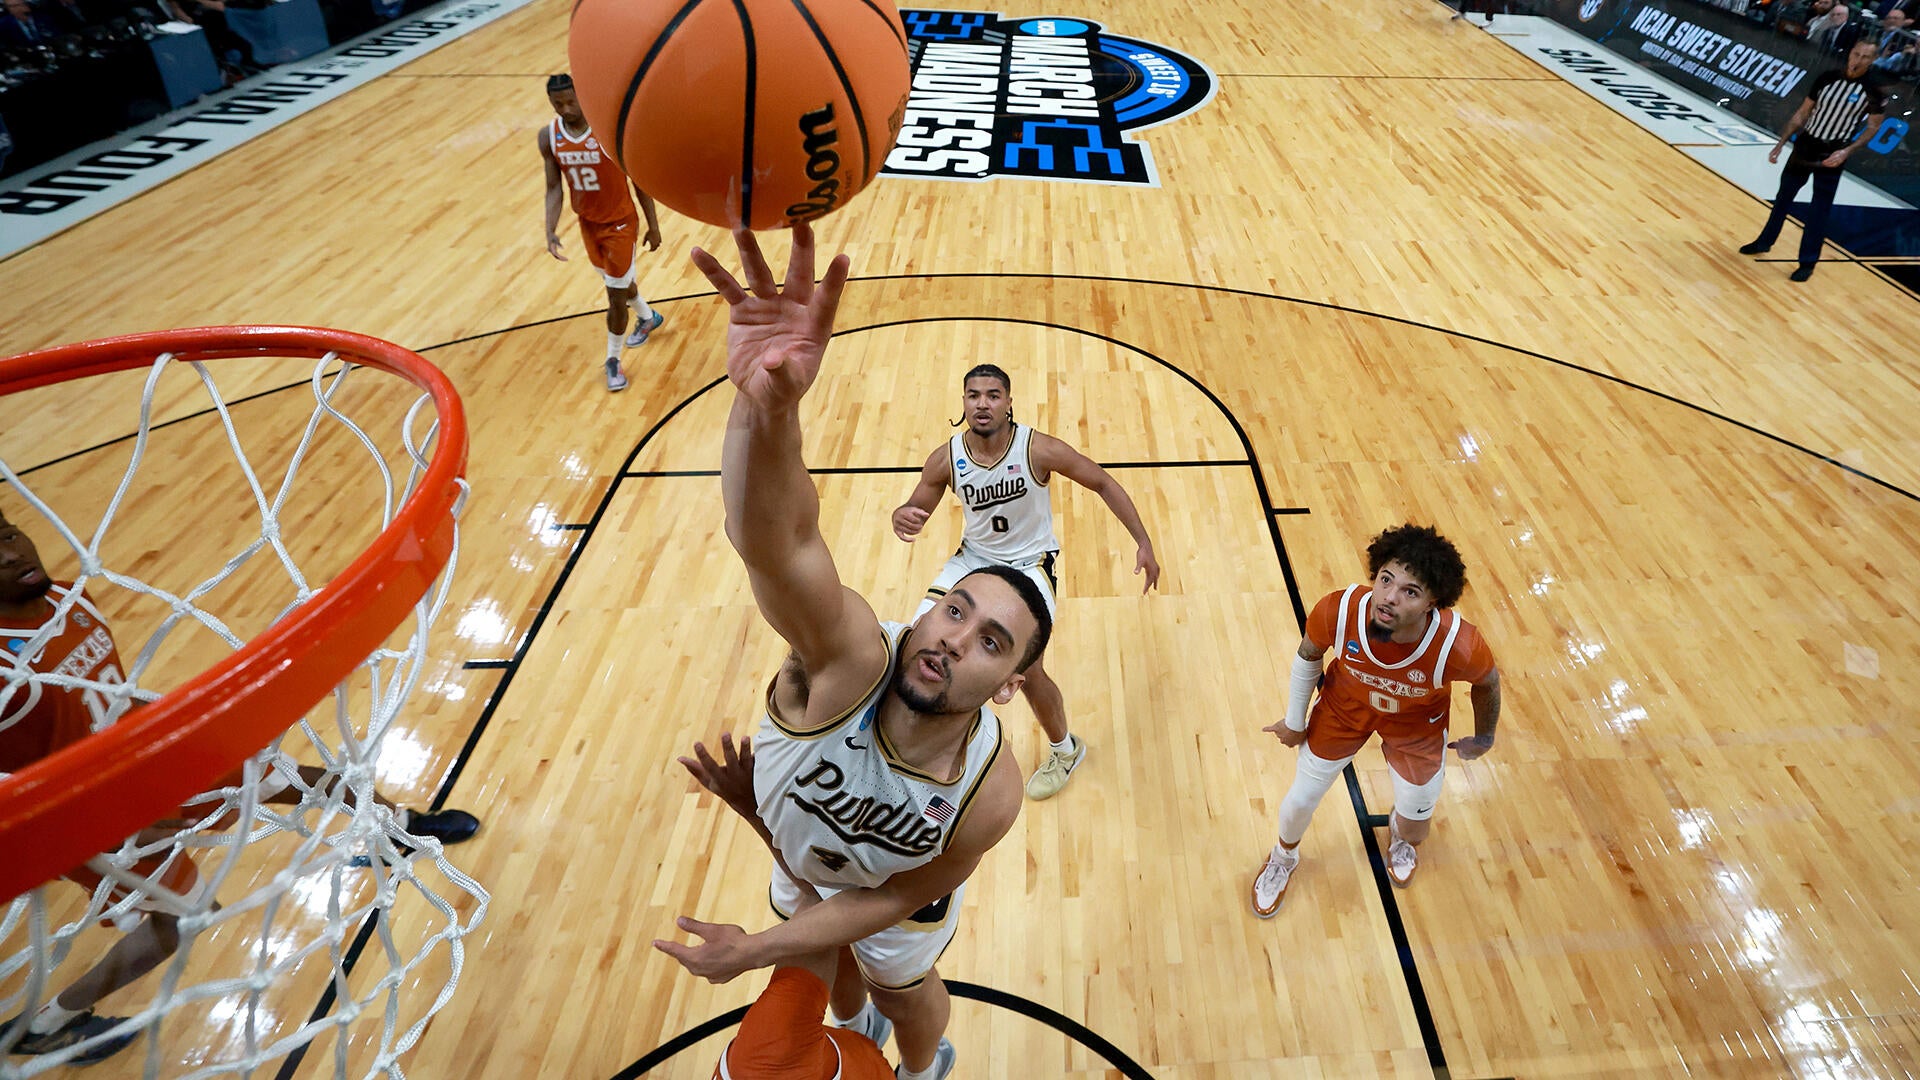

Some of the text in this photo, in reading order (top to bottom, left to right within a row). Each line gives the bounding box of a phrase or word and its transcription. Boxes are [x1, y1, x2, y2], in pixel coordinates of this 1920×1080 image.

[336, 20, 460, 57] ROAD
[1630, 5, 1807, 98] NCAA SWEET SIXTEEN
[1006, 35, 1100, 117] MARCH
[1129, 53, 1181, 96] SWEET 16
[1538, 48, 1715, 123] SAN JOSE
[1660, 50, 1674, 60] BY
[1667, 53, 1685, 67] SAN
[1694, 66, 1718, 83] STATE
[1712, 74, 1754, 99] UNIVERSITY
[167, 72, 348, 127] FINAL
[884, 42, 1003, 173] MADNESS
[0, 136, 211, 215] FOUR
[557, 151, 601, 165] TEXAS
[568, 167, 601, 191] 12
[961, 476, 1027, 508] Purdue
[991, 515, 1009, 532] 0
[1344, 664, 1429, 697] TEXAS
[1369, 690, 1399, 713] 0
[786, 754, 942, 856] Purdue
[809, 845, 850, 872] 4
